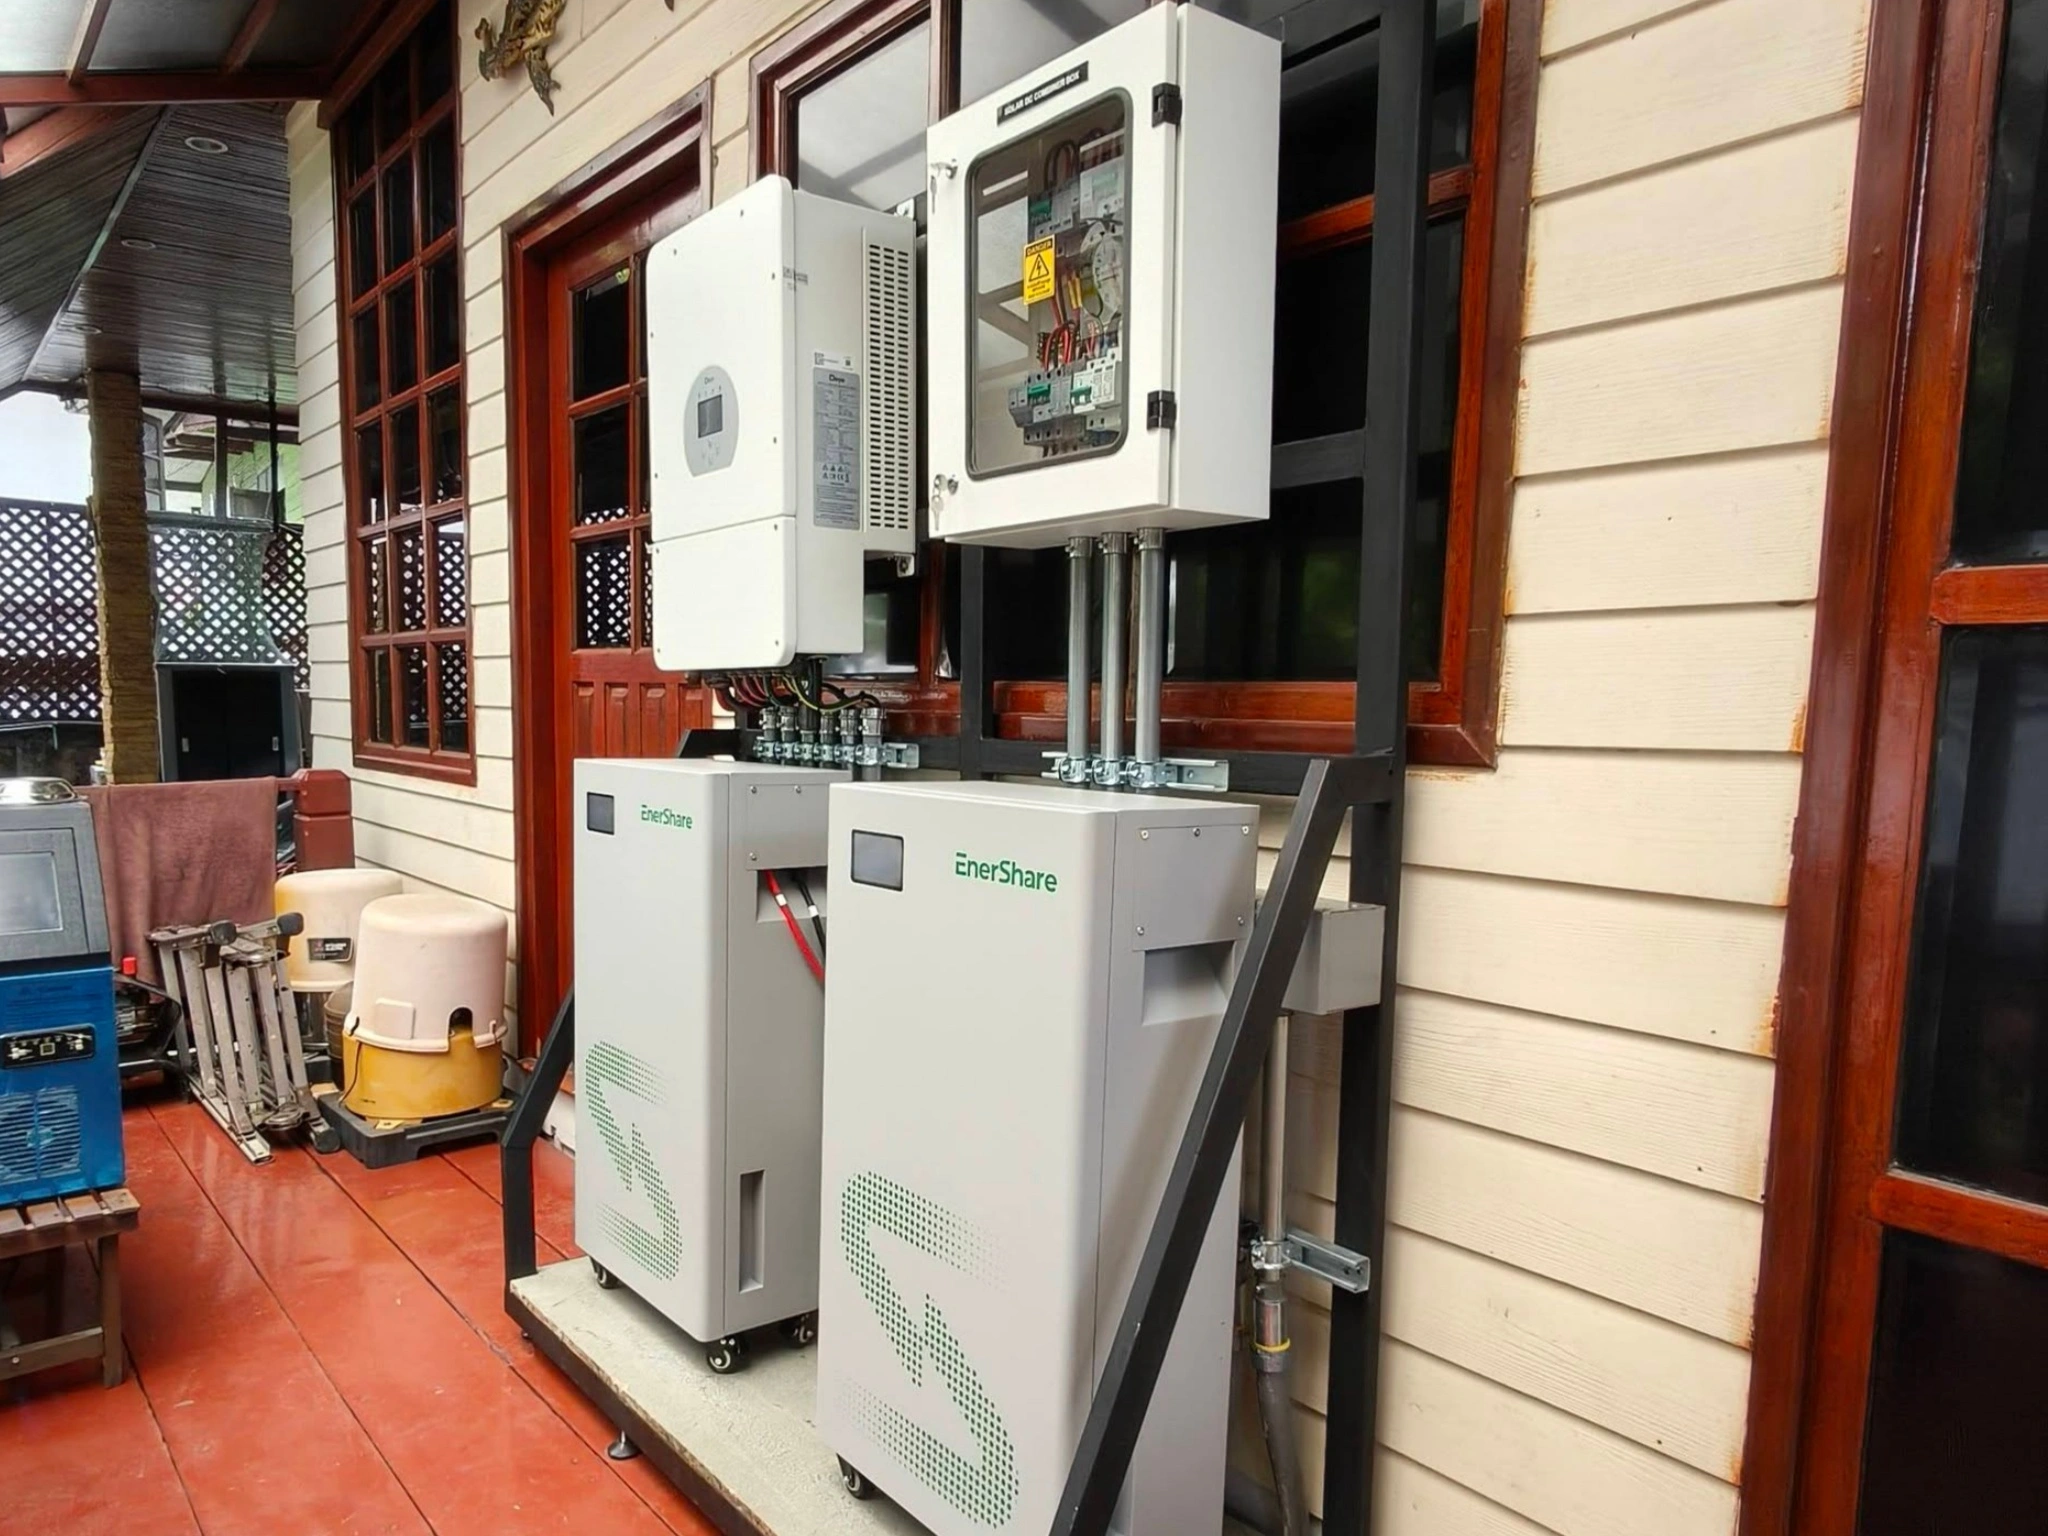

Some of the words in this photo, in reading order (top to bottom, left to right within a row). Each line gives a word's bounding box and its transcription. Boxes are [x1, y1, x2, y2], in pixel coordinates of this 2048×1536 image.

[1004, 98, 1024, 115] SOLAR
[1025, 93, 1034, 106] DC
[1065, 70, 1080, 85] BOX
[641, 804, 693, 829] EnerShare
[955, 852, 1058, 892] EnerShare
